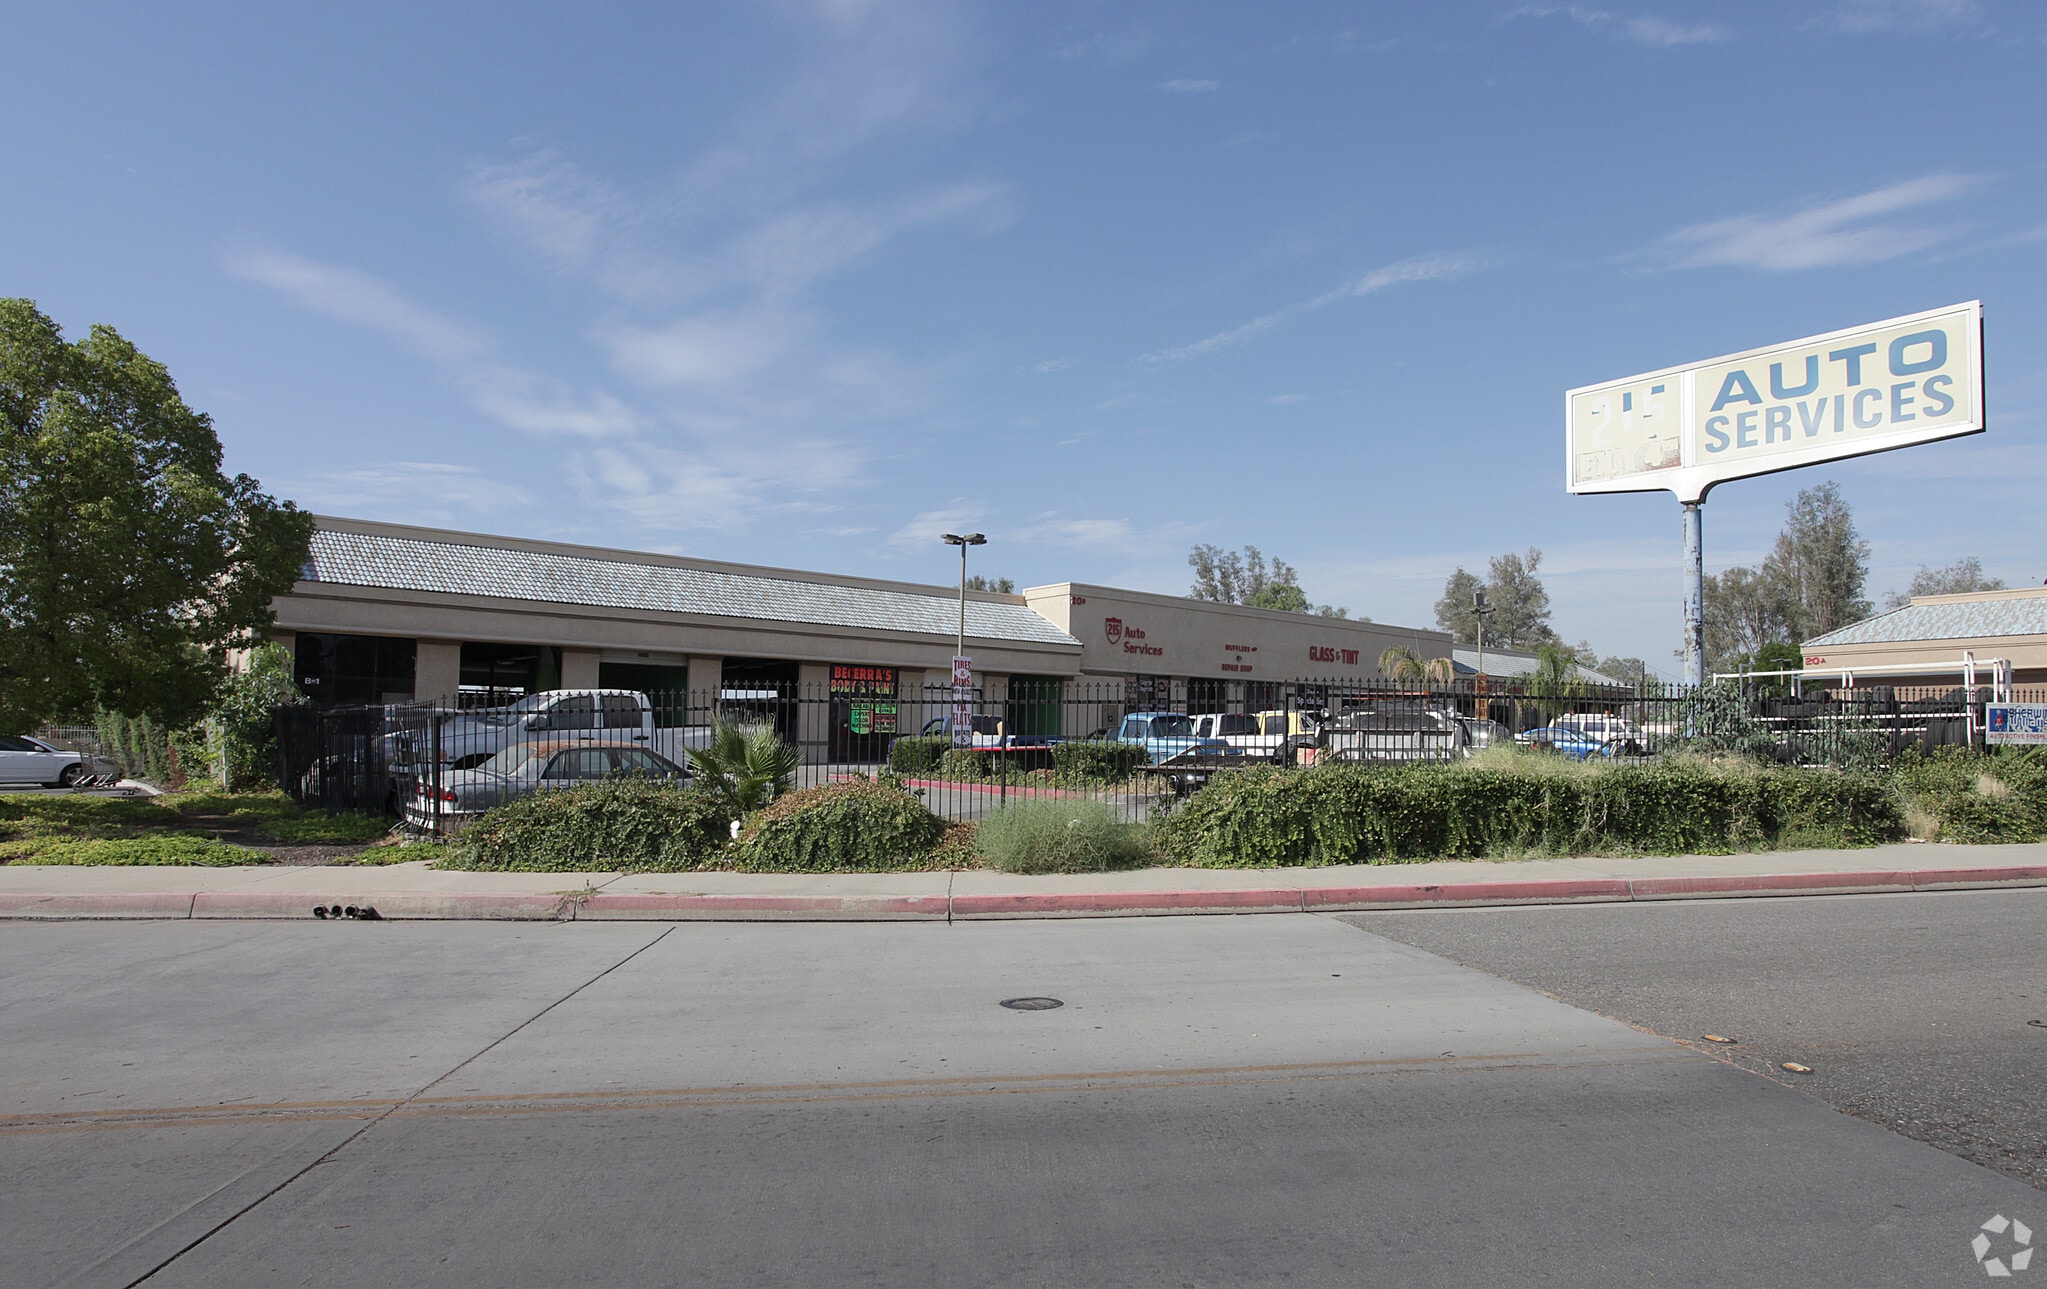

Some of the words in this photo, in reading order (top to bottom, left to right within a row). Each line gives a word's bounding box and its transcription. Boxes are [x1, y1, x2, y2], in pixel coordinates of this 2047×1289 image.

[1709, 329, 1948, 413] AUTO
[1703, 374, 1955, 453] SERVICES
[1108, 623, 1120, 635] 215
[1124, 626, 1146, 639] Auto
[1123, 641, 1164, 656] Services
[1225, 644, 1251, 653] MUFFLERS
[1309, 646, 1335, 662] GLASS
[1341, 649, 1360, 665] TINT
[953, 660, 972, 673] TIRES
[1221, 663, 1239, 672] REPAIR
[304, 677, 320, 685] B-1
[830, 679, 857, 693] BODY
[953, 674, 971, 688] RIMS
[953, 713, 971, 726] FLATS
